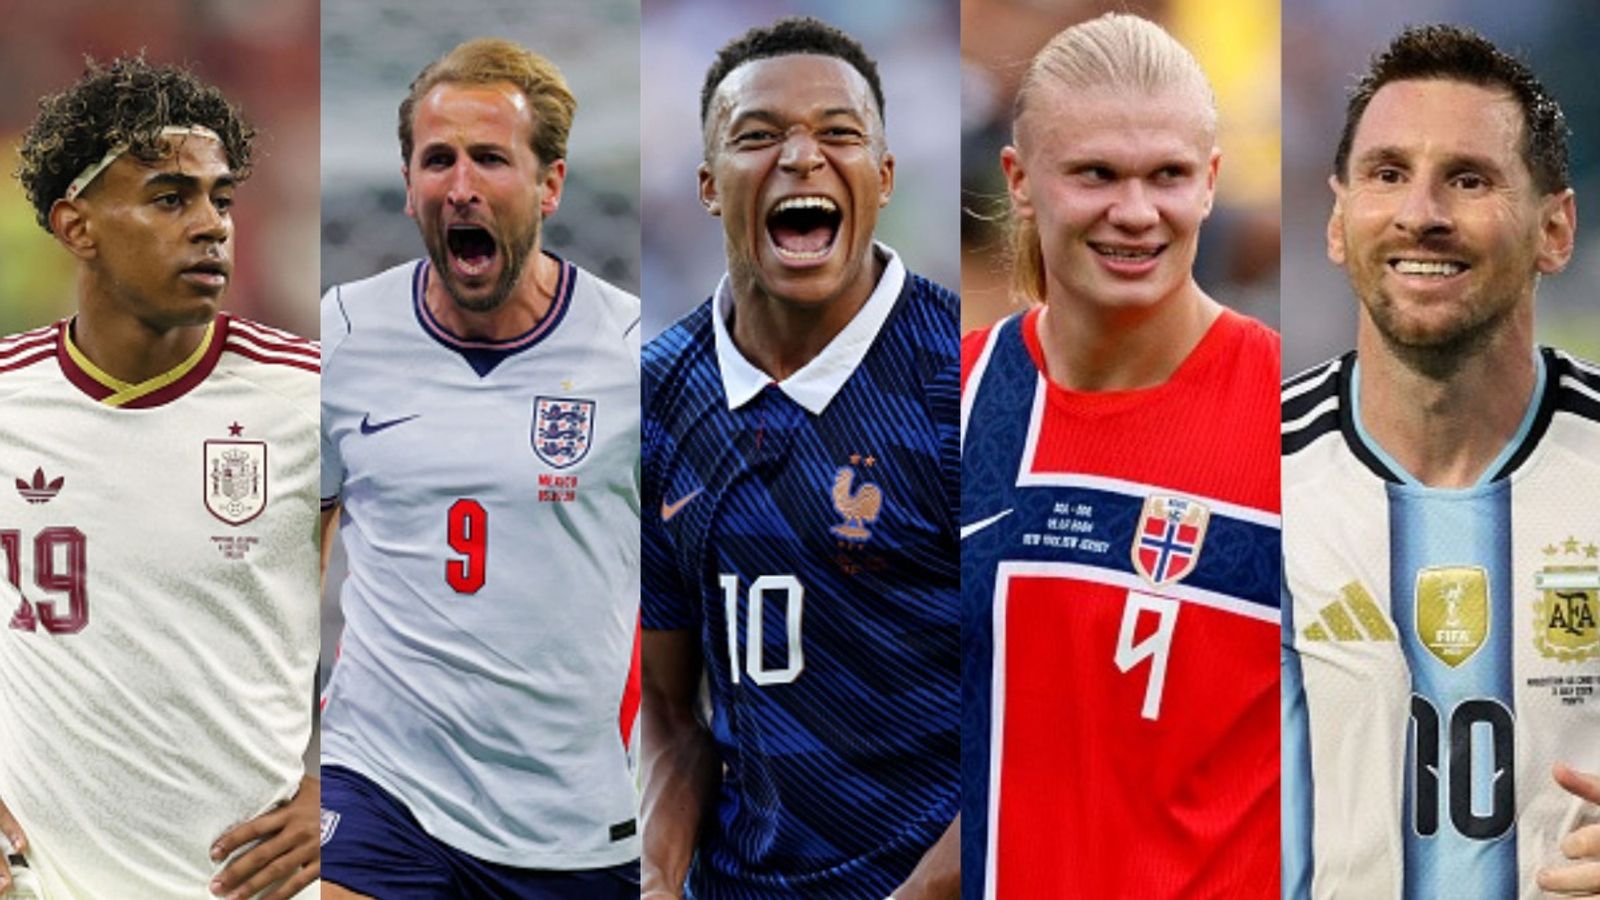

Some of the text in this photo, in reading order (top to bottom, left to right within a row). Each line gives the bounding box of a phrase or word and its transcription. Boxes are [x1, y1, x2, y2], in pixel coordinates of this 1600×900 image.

[0, 525, 89, 634] 19
[445, 498, 488, 595] 9
[718, 573, 804, 686] 10
[1114, 589, 1181, 721] 9
[1435, 630, 1470, 643] FIFA
[1548, 591, 1597, 637] AFA
[1410, 693, 1516, 841] 10
